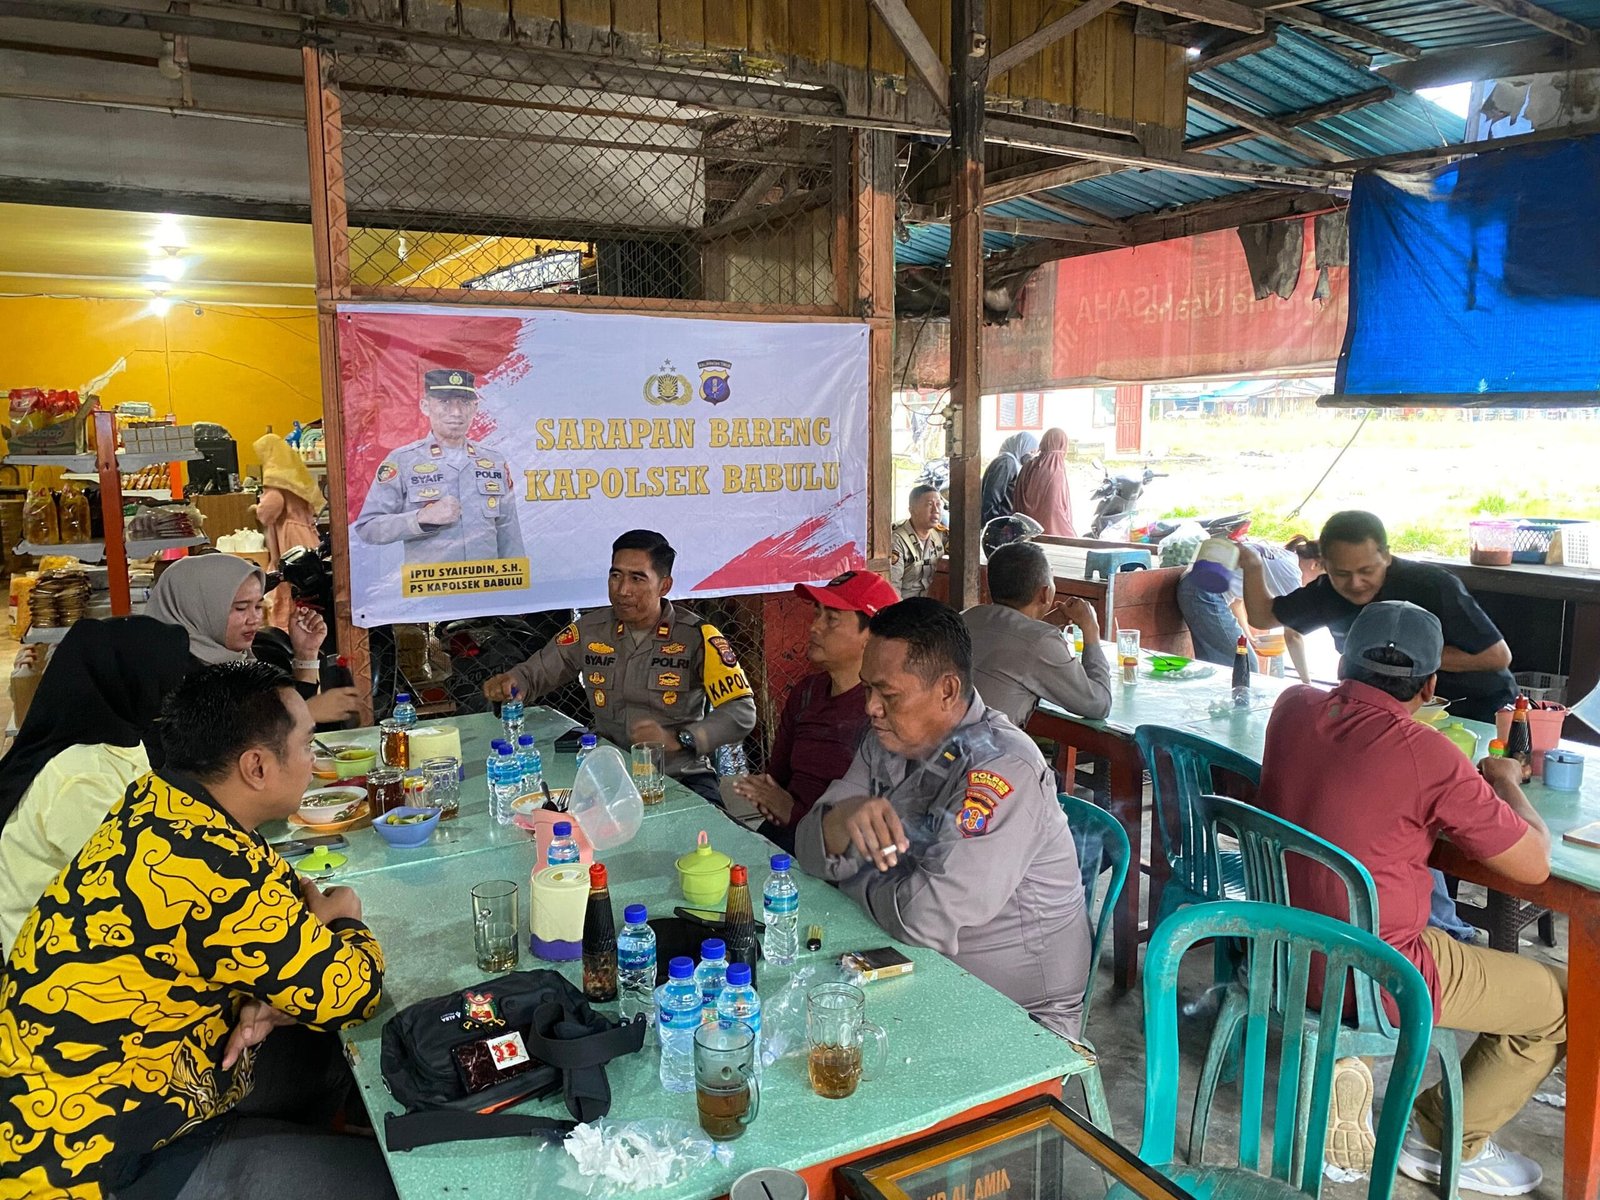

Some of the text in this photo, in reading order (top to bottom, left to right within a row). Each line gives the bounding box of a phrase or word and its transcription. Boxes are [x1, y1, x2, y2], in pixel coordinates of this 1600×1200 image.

[535, 416, 831, 450] SARAPAN BARENG
[411, 473, 444, 485] SYAIF
[475, 470, 502, 479] POLRI
[523, 461, 841, 502] KAPOLSEK BABULU
[410, 563, 522, 579] IPTU SYAIFUDIN, S.H.
[410, 577, 523, 593] PS KAPOLSEK BABULU
[584, 654, 616, 667] SYAIF
[651, 656, 690, 669] POLRI
